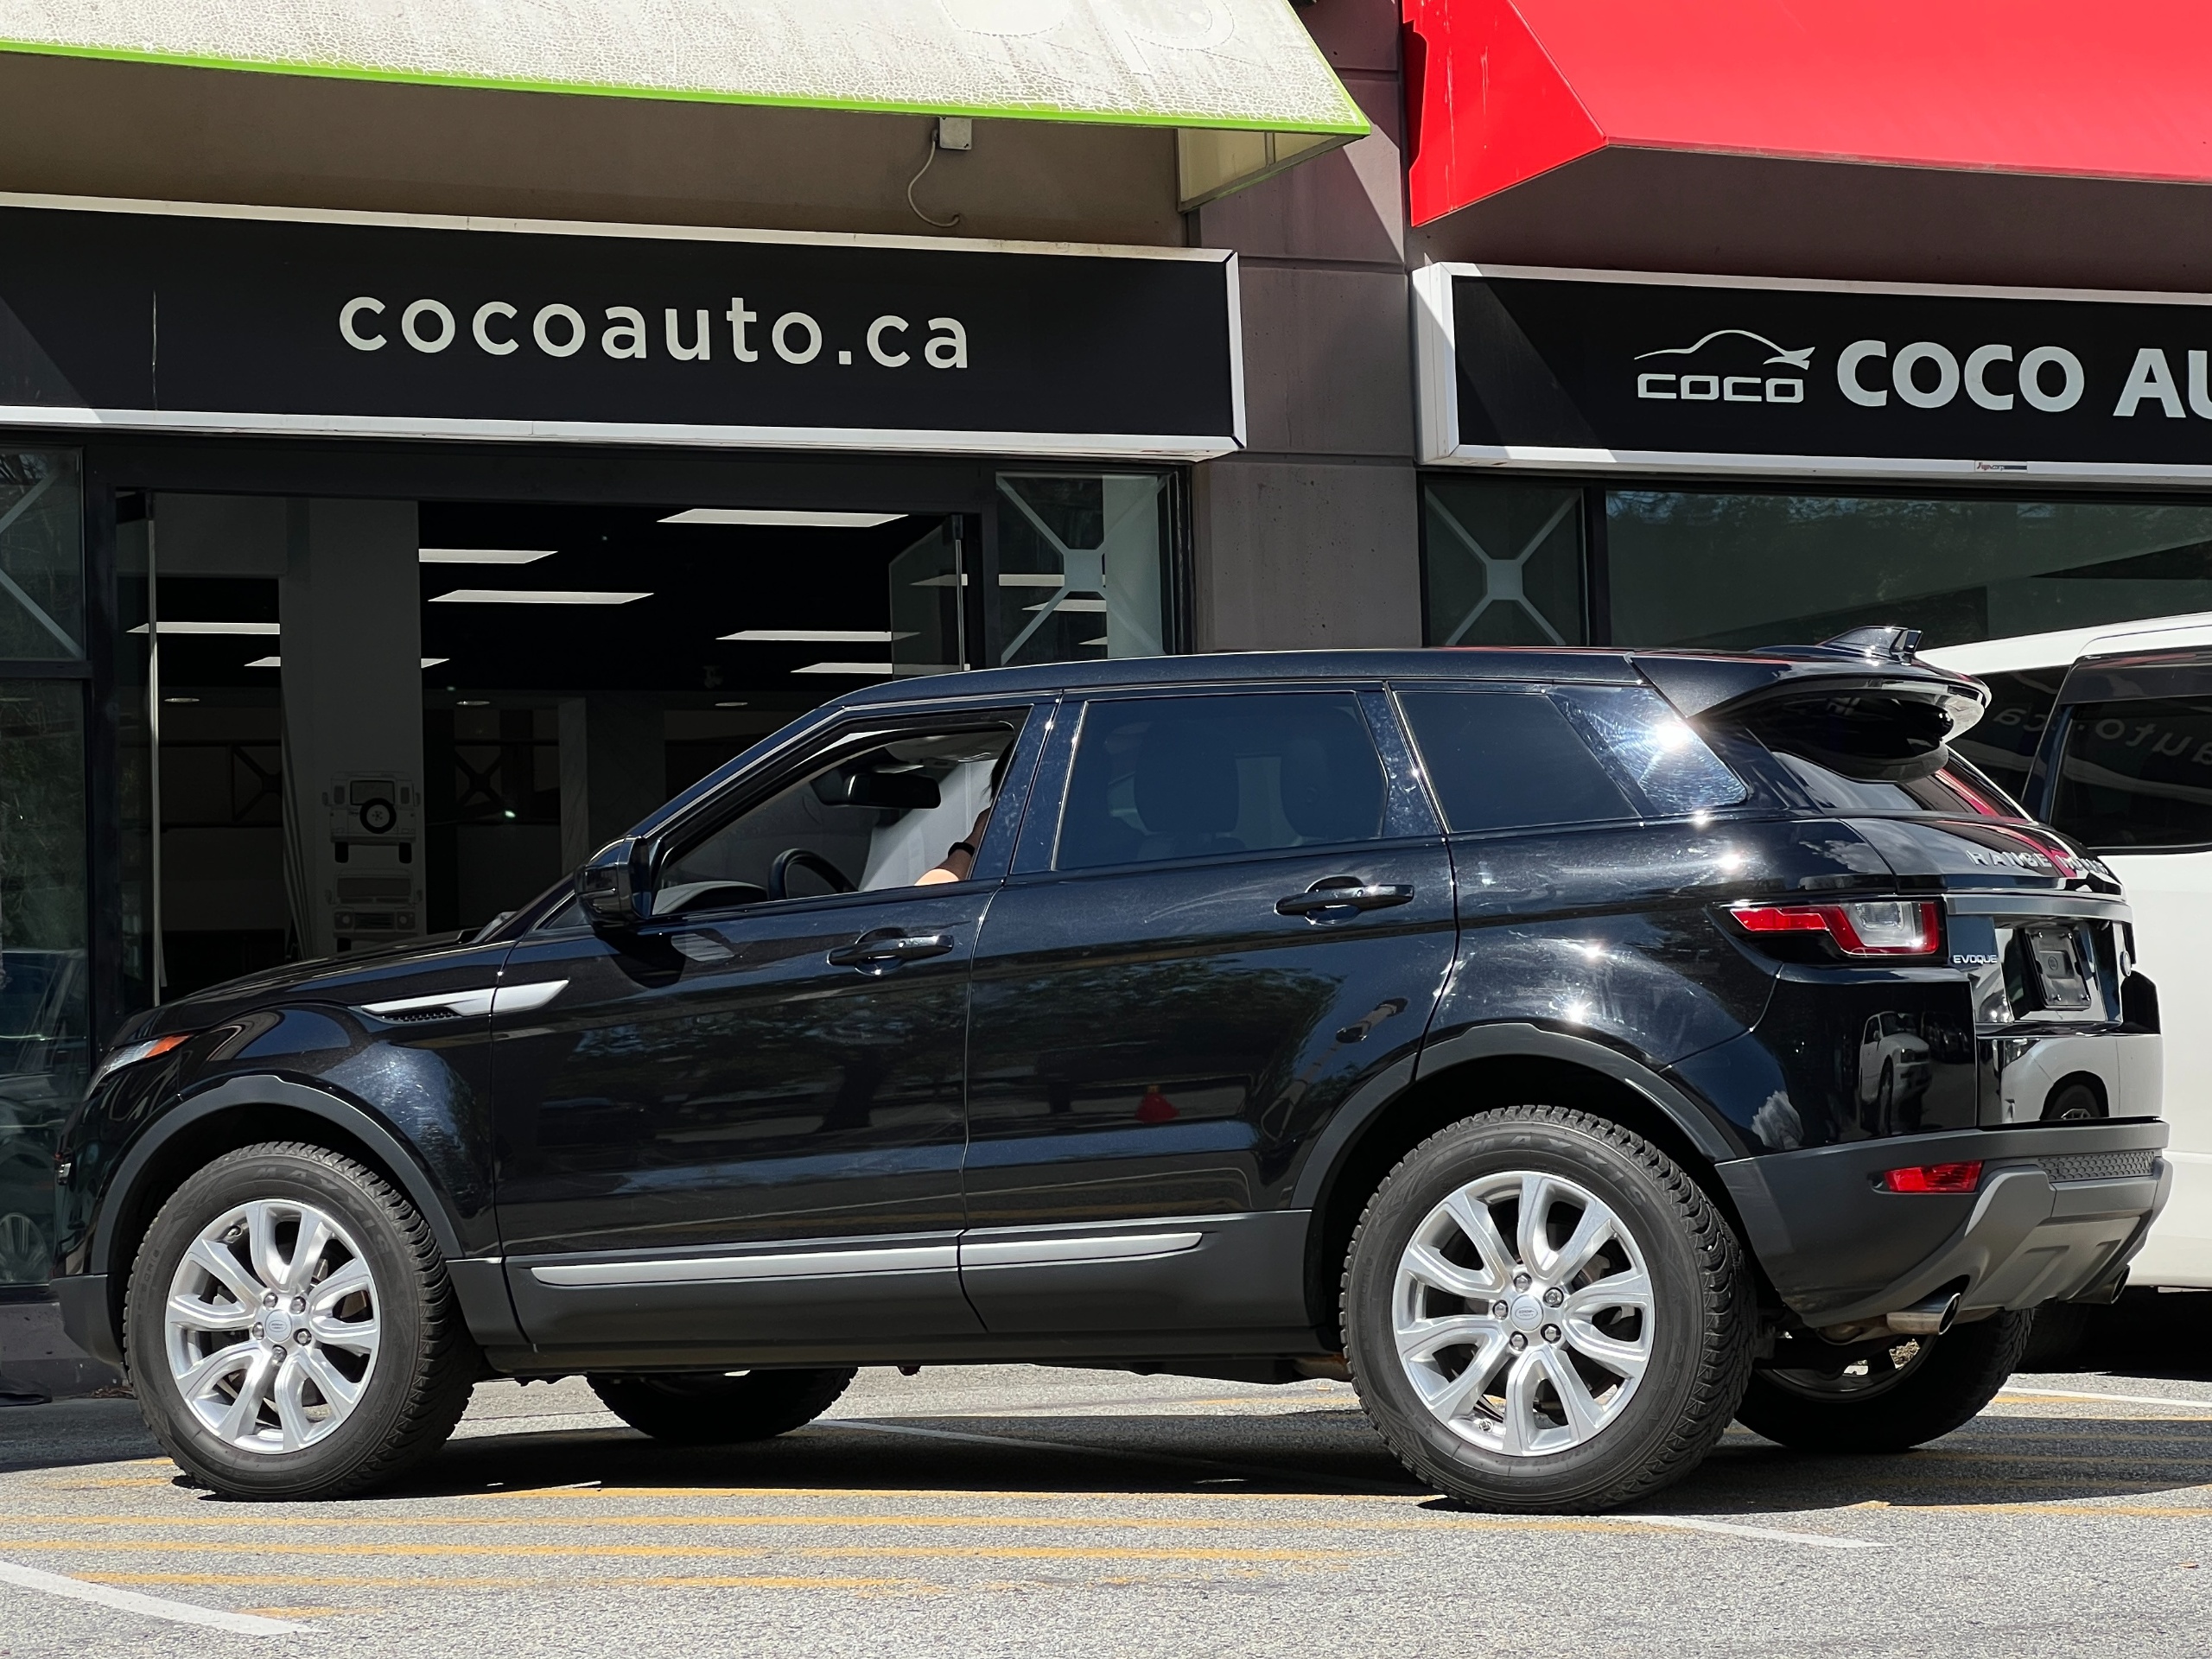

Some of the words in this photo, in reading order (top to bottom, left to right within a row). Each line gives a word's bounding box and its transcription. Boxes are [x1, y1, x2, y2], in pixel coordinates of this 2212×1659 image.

[339, 296, 969, 370] cocoauto.ca
[1637, 373, 1804, 404] COCO
[1837, 340, 2085, 413] COCO
[1966, 850, 2053, 868] RANGE
[1953, 954, 1998, 964] EVOQUE
[1470, 1135, 1648, 1206] MAXXIS
